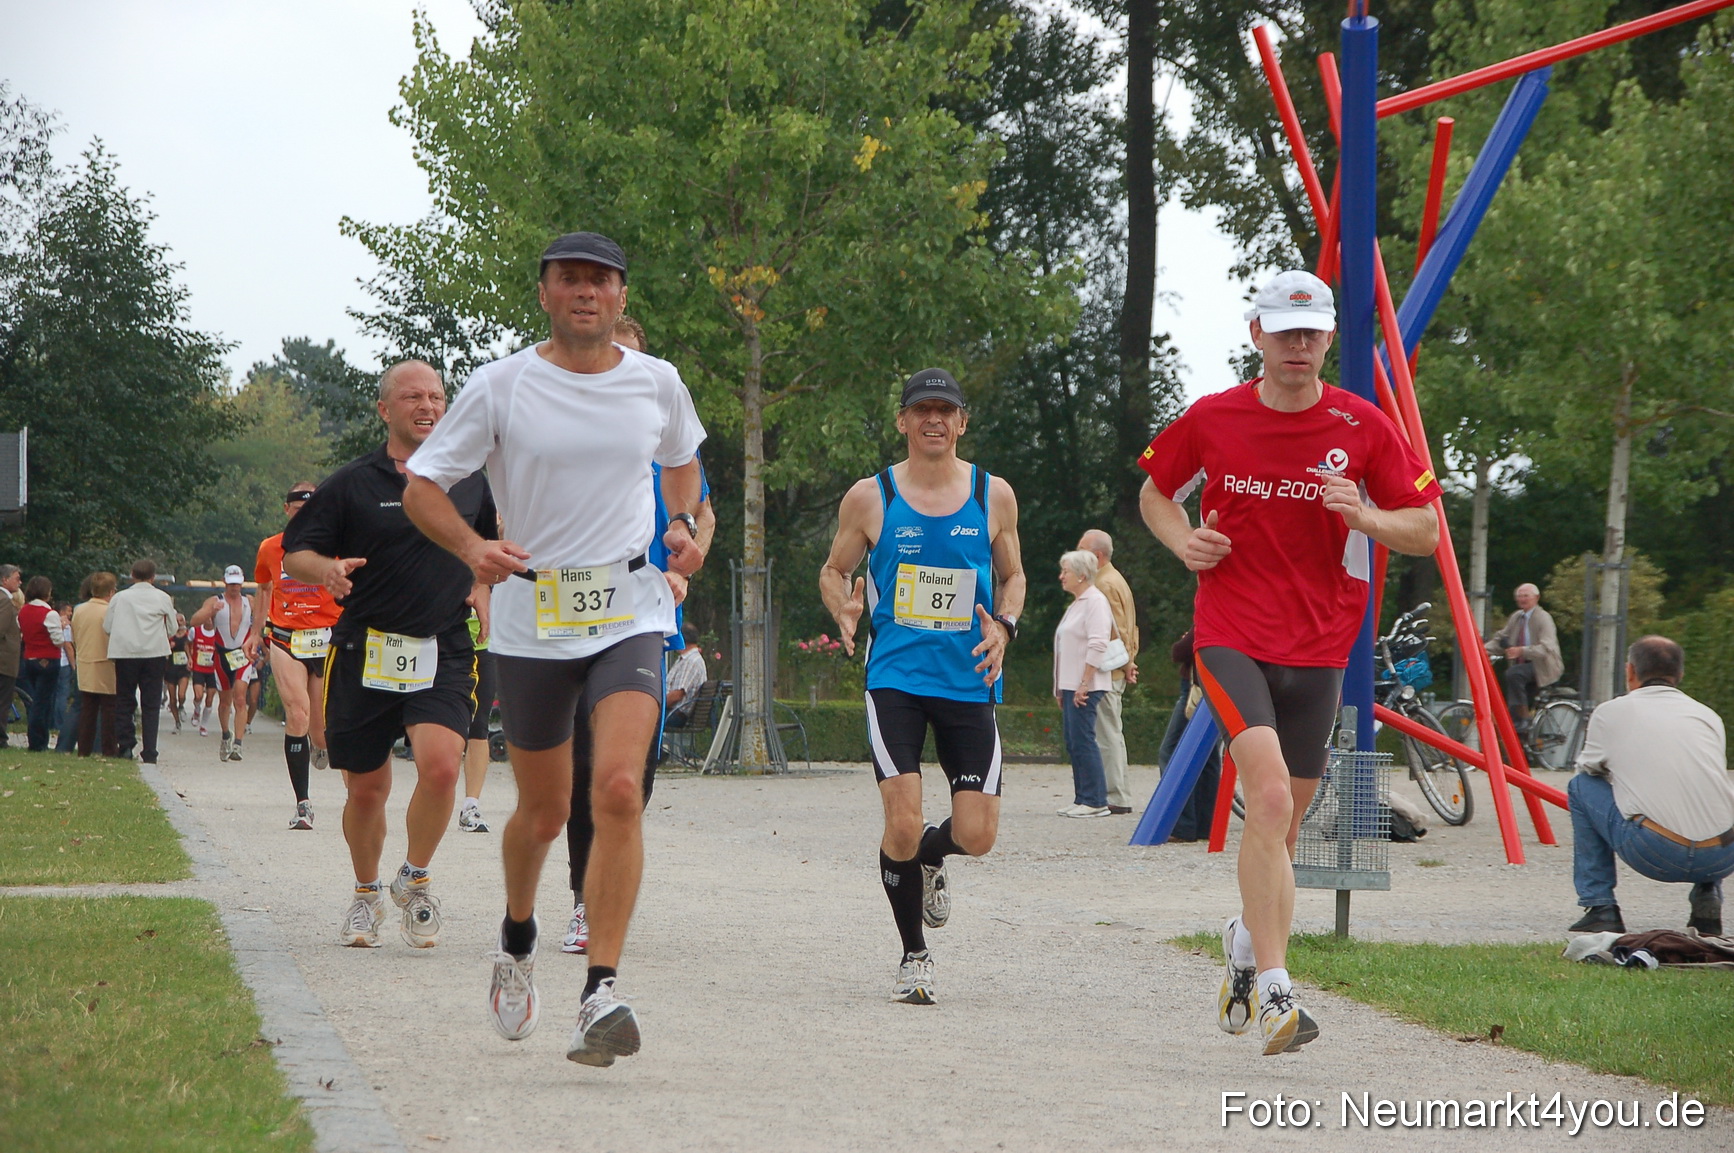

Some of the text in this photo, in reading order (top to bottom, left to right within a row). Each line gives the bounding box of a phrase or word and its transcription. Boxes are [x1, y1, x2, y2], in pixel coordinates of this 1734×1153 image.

[1224, 474, 1273, 499] Relay
[561, 569, 592, 583] Hans
[919, 571, 953, 586] Roland
[540, 591, 547, 602] B
[899, 587, 905, 597] B
[572, 587, 617, 613] 337
[931, 592, 957, 610] 87
[310, 639, 323, 648] 83
[369, 650, 375, 659] B
[396, 656, 418, 672] 91
